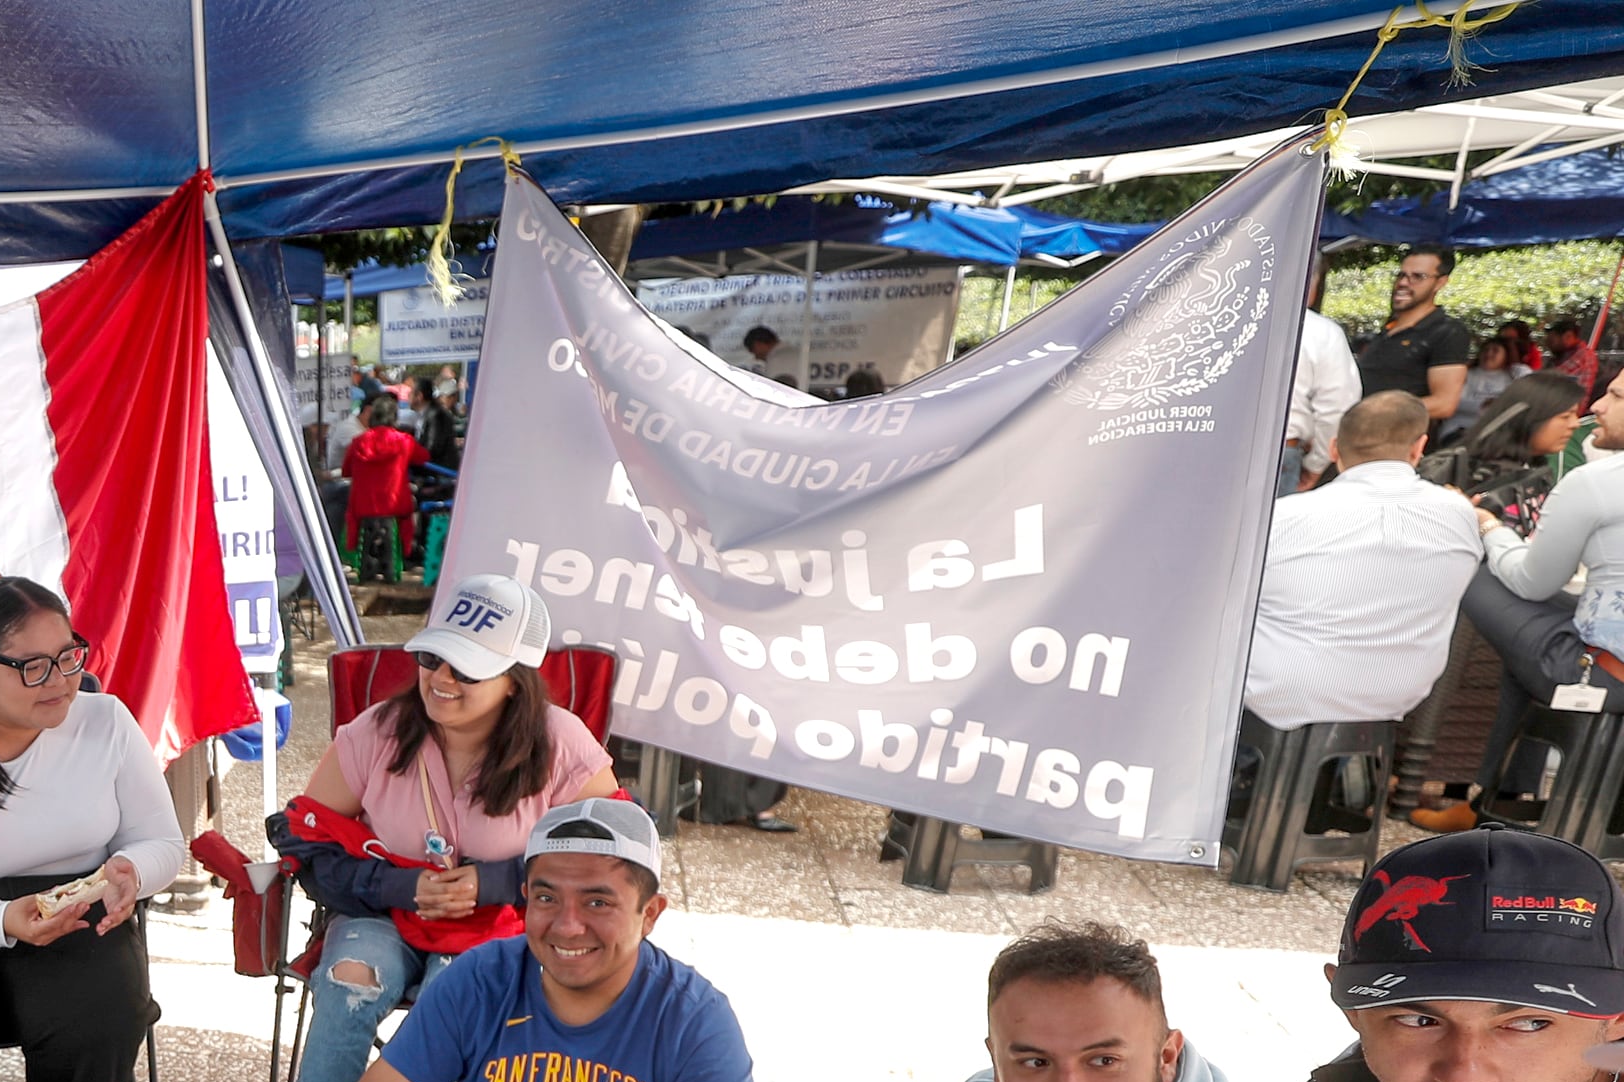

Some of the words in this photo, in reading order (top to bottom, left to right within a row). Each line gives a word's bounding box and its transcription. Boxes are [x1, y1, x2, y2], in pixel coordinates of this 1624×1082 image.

[795, 289, 821, 303] DL
[826, 285, 882, 303] PRIMER
[445, 599, 505, 633] PJF
[1492, 895, 1525, 910] Red
[1525, 895, 1556, 911] Bull
[1491, 911, 1595, 929] RACING
